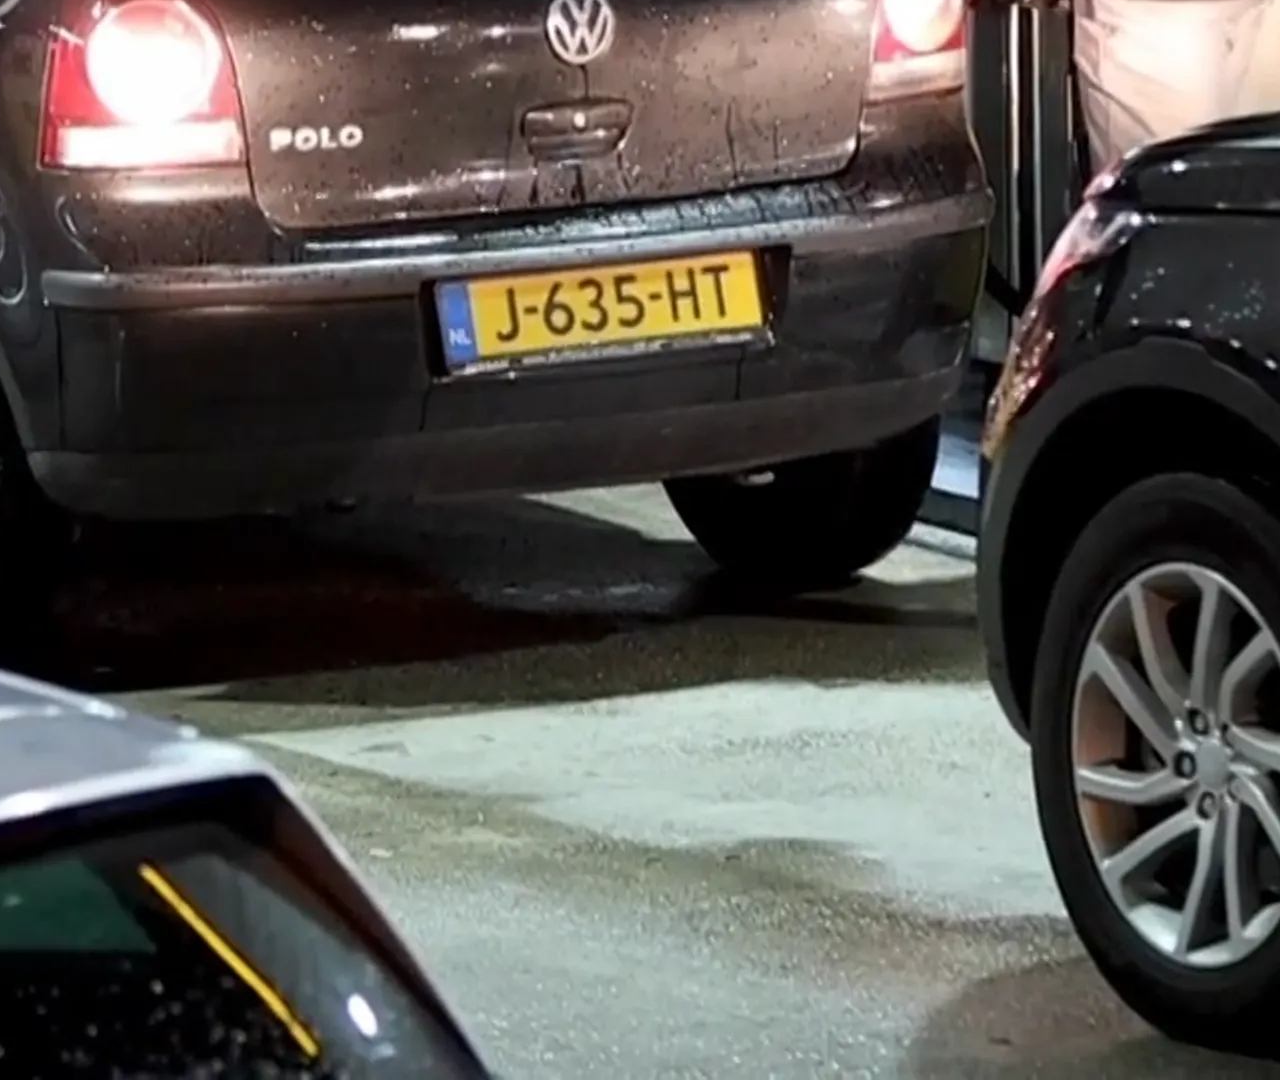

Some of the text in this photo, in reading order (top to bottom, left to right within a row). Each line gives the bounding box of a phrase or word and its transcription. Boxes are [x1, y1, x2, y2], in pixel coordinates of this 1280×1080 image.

[269, 124, 363, 152] POLO
[495, 264, 731, 344] J-635-HT
[448, 327, 472, 345] NL
